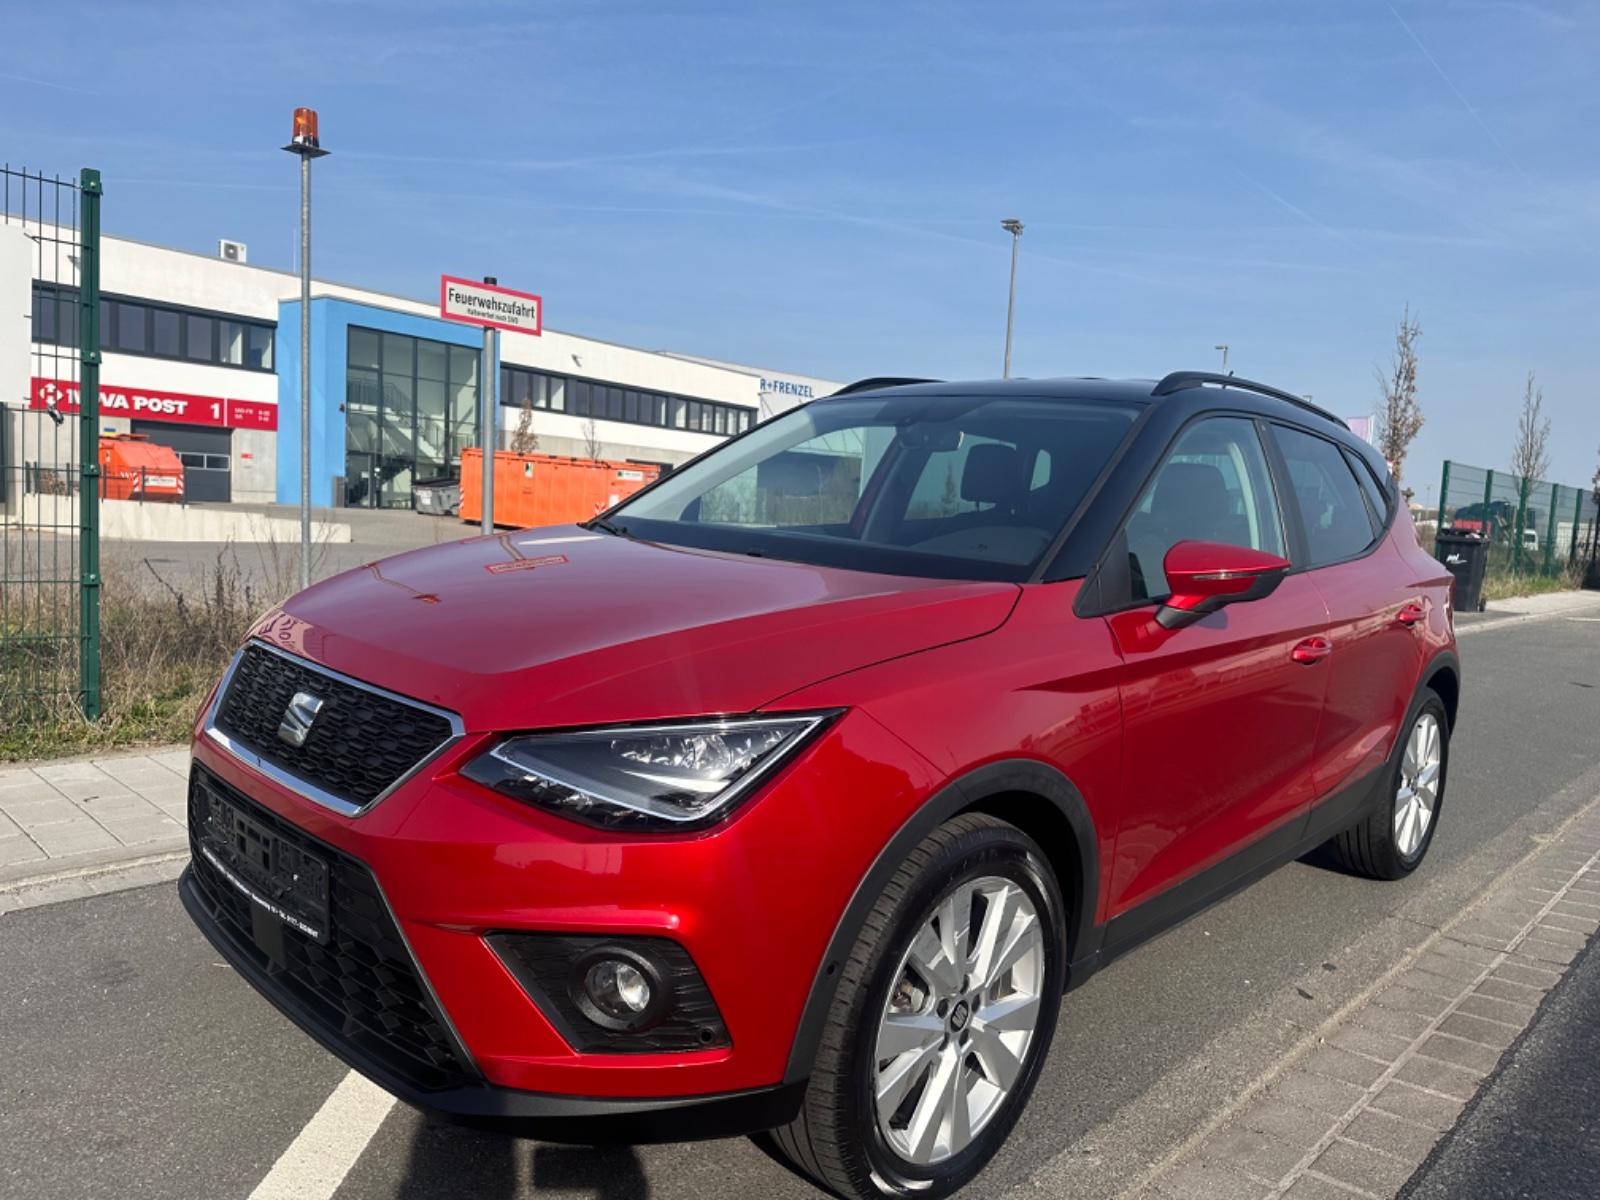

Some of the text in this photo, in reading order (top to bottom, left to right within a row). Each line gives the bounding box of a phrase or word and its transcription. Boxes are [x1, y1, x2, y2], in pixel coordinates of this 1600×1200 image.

[66, 388, 188, 415] NVA POST
[210, 402, 220, 420] 1
